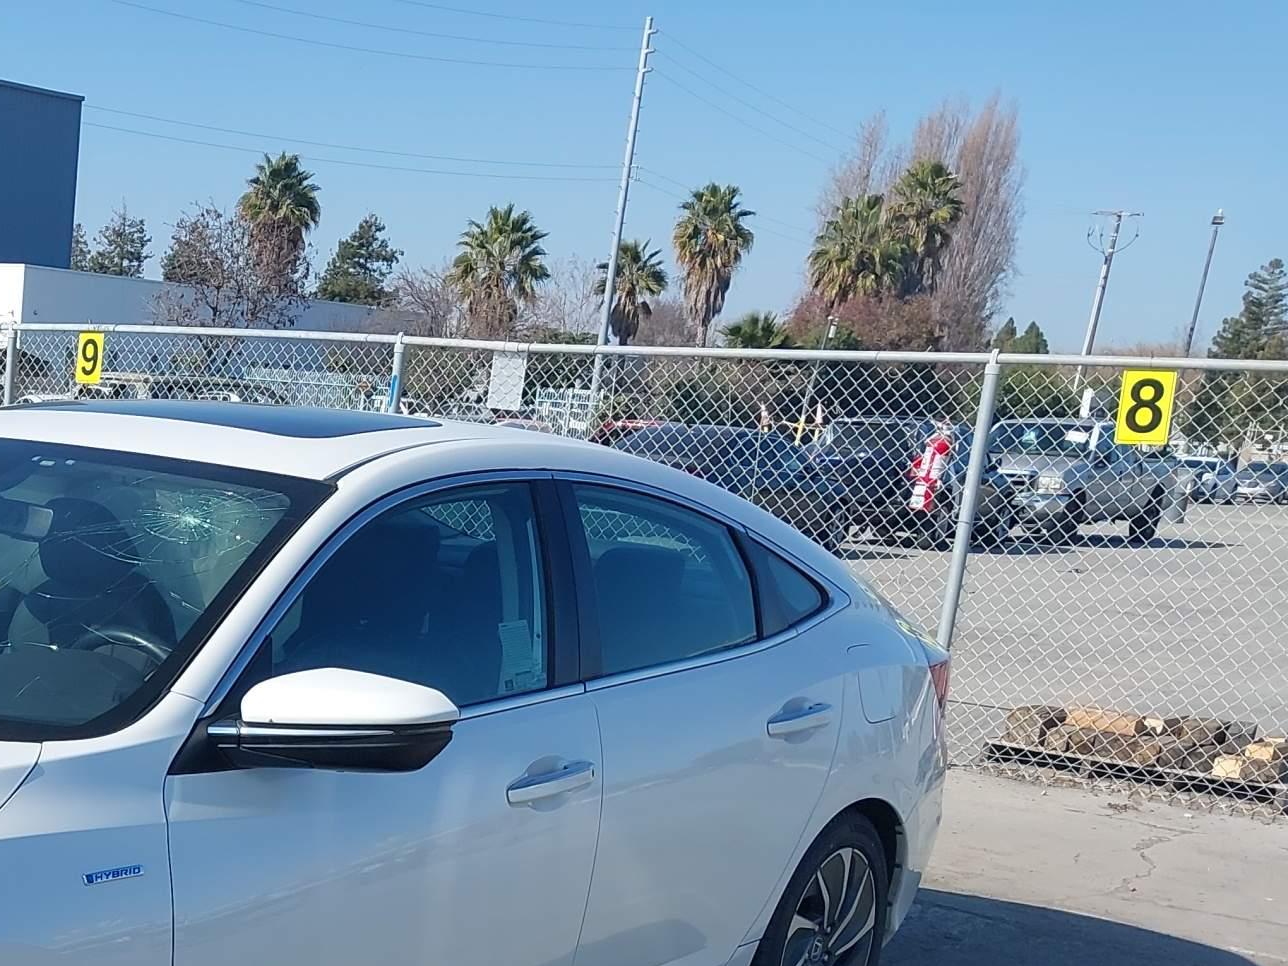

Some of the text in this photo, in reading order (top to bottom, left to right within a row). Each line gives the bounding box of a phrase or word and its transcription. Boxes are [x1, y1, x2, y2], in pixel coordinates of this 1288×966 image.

[81, 338, 99, 376] 9
[1125, 377, 1165, 434] 8
[94, 865, 142, 882] HYBRID
